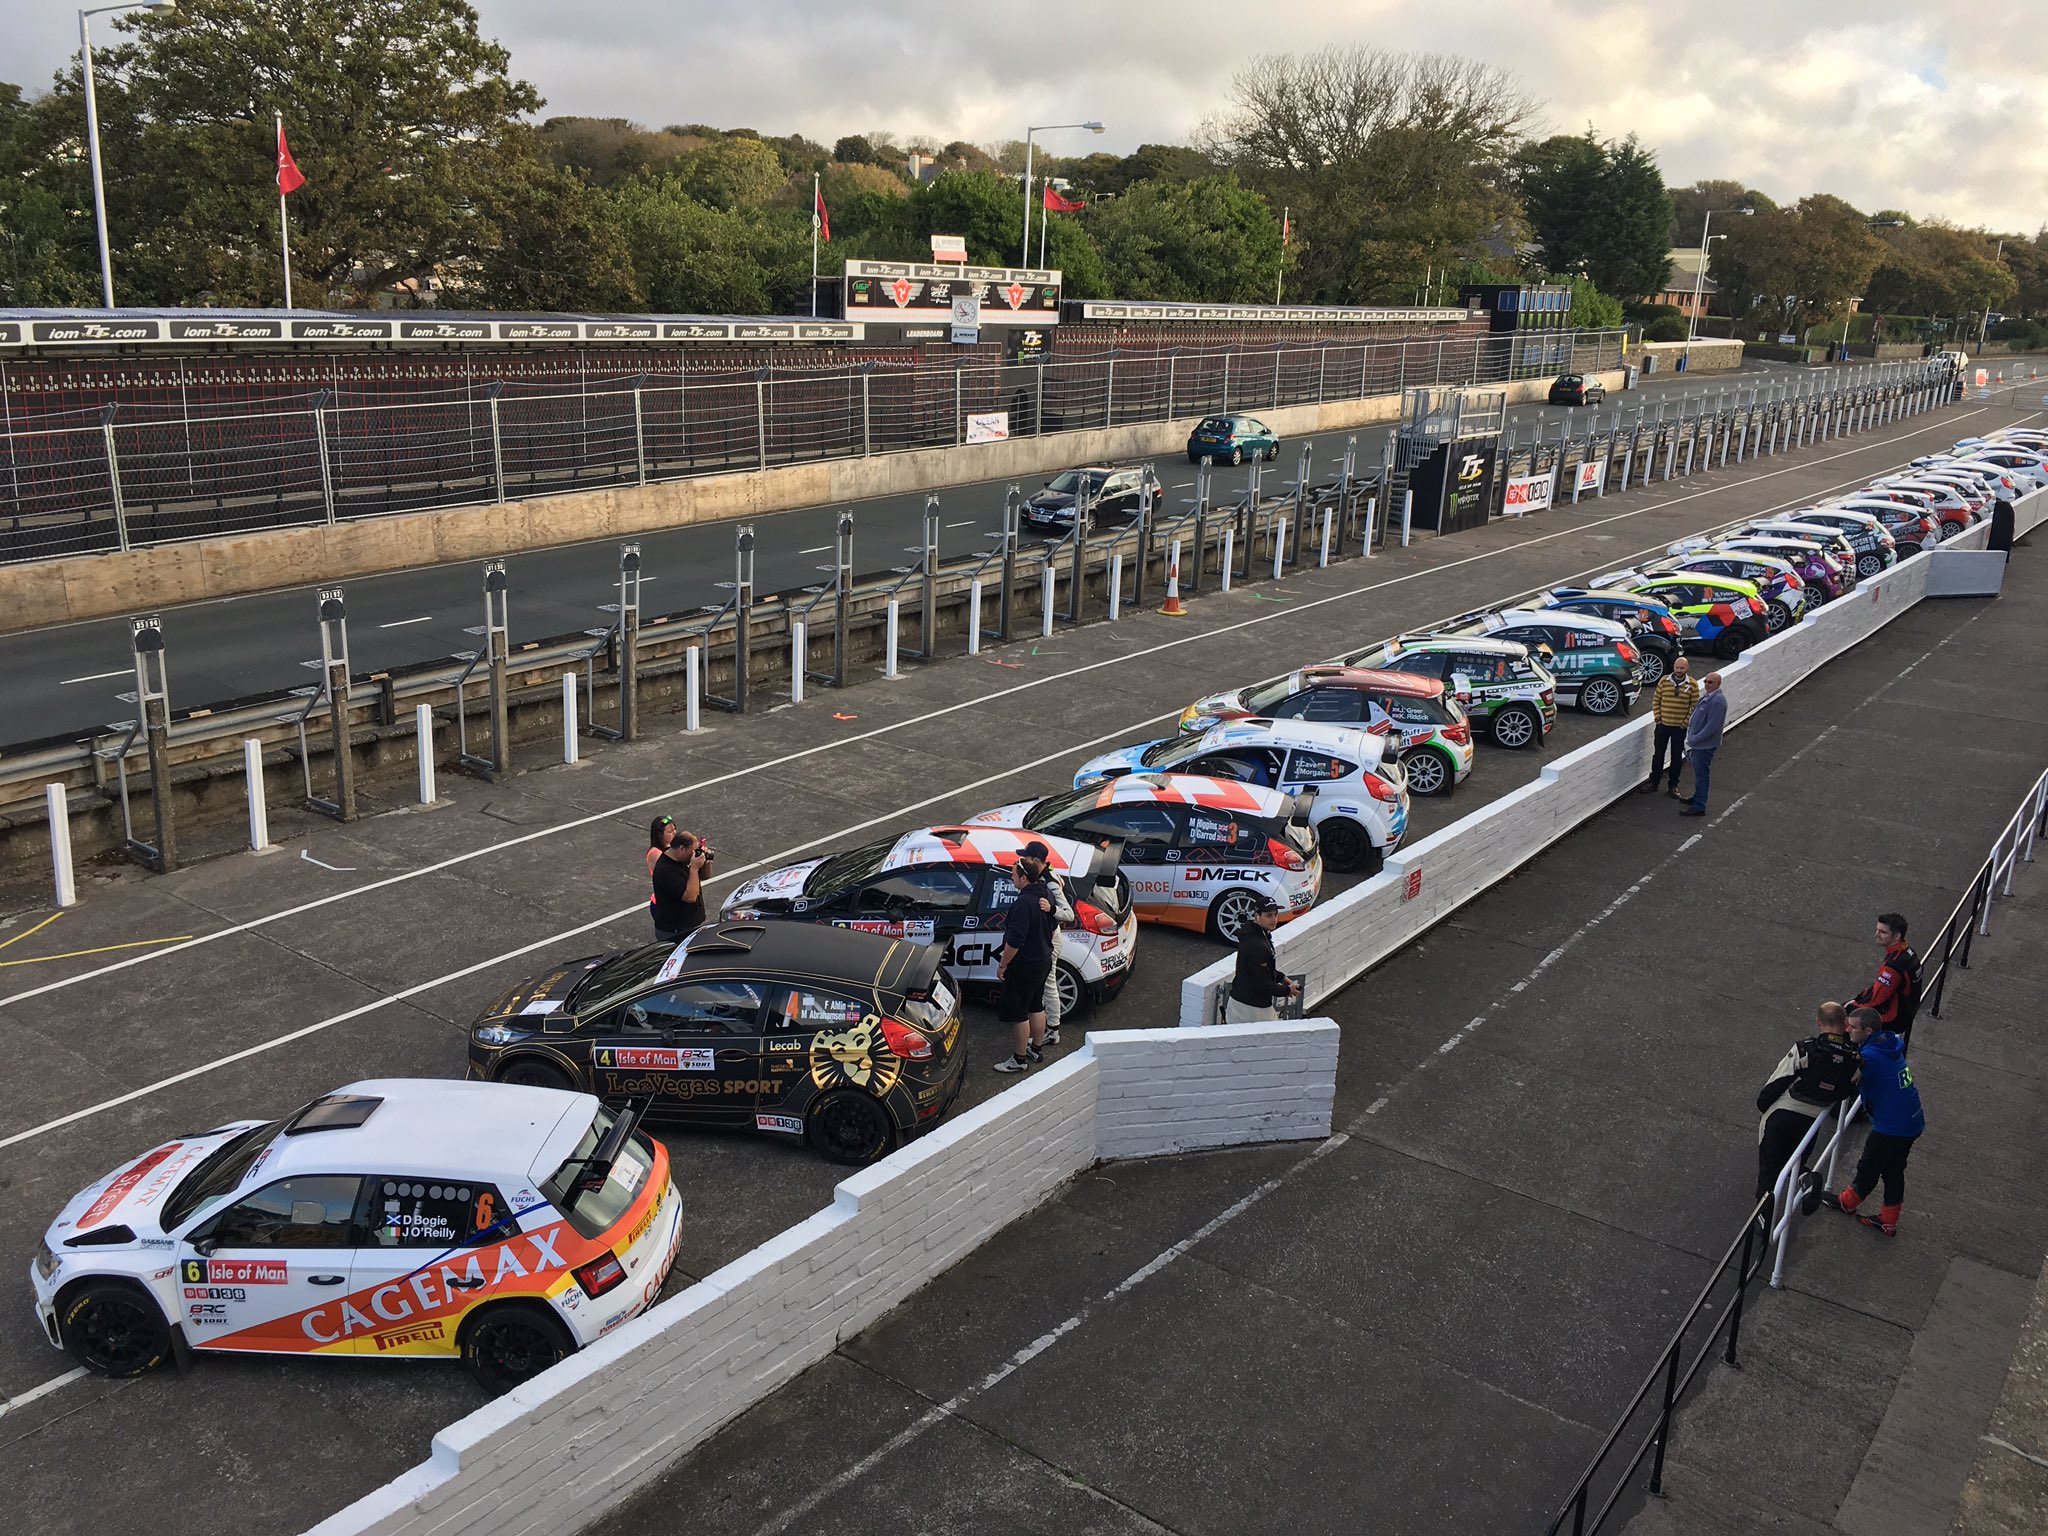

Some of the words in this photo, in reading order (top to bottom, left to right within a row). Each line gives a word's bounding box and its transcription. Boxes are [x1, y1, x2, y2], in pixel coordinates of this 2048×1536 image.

[906, 330, 944, 338] LEADERBOARD
[1462, 454, 1484, 478] TT
[1894, 524, 1921, 536] OTORS
[1543, 653, 1616, 670] WIFT
[1486, 682, 1545, 694] CONSTRUCTION
[1385, 698, 1392, 714] 7
[1402, 729, 1421, 737] duff
[1330, 759, 1340, 779] 5
[1189, 818, 1195, 827] M
[1197, 819, 1218, 832] Higgins
[1190, 829, 1195, 838] D
[1196, 831, 1217, 842] Garrod
[1227, 822, 1238, 844] 3
[883, 925, 903, 937] Man
[906, 921, 932, 929] BRC
[1101, 951, 1125, 965] DRIVE
[785, 991, 799, 1020] 4
[824, 1000, 829, 1009] F
[831, 1000, 847, 1011] Ahlin
[801, 1010, 808, 1018] M
[810, 1010, 846, 1020] Abrahamsen
[770, 1039, 801, 1051] Lecab
[600, 1050, 611, 1066] 4
[618, 1052, 636, 1065] Isle
[639, 1051, 651, 1064] of
[653, 1053, 677, 1065] Man
[681, 1050, 710, 1058] BRC
[606, 1072, 720, 1099] LeoVegas
[724, 1080, 783, 1094] SPORT
[246, 1149, 273, 1179] BRC
[134, 1146, 204, 1206] CAGEMAX
[476, 1192, 494, 1231] 6
[403, 1215, 412, 1225] D
[415, 1215, 448, 1228] Bogie
[402, 1227, 409, 1237] J
[412, 1226, 456, 1240] O'Reilly
[187, 1261, 201, 1282] 6
[211, 1264, 234, 1280] Isle
[237, 1263, 252, 1280] of
[255, 1266, 286, 1280] Man
[302, 1227, 567, 1343] CAGEMAX
[561, 1290, 584, 1308] FUCHS
[190, 1304, 226, 1313] BRC
[373, 1321, 446, 1351] PIRELLI
